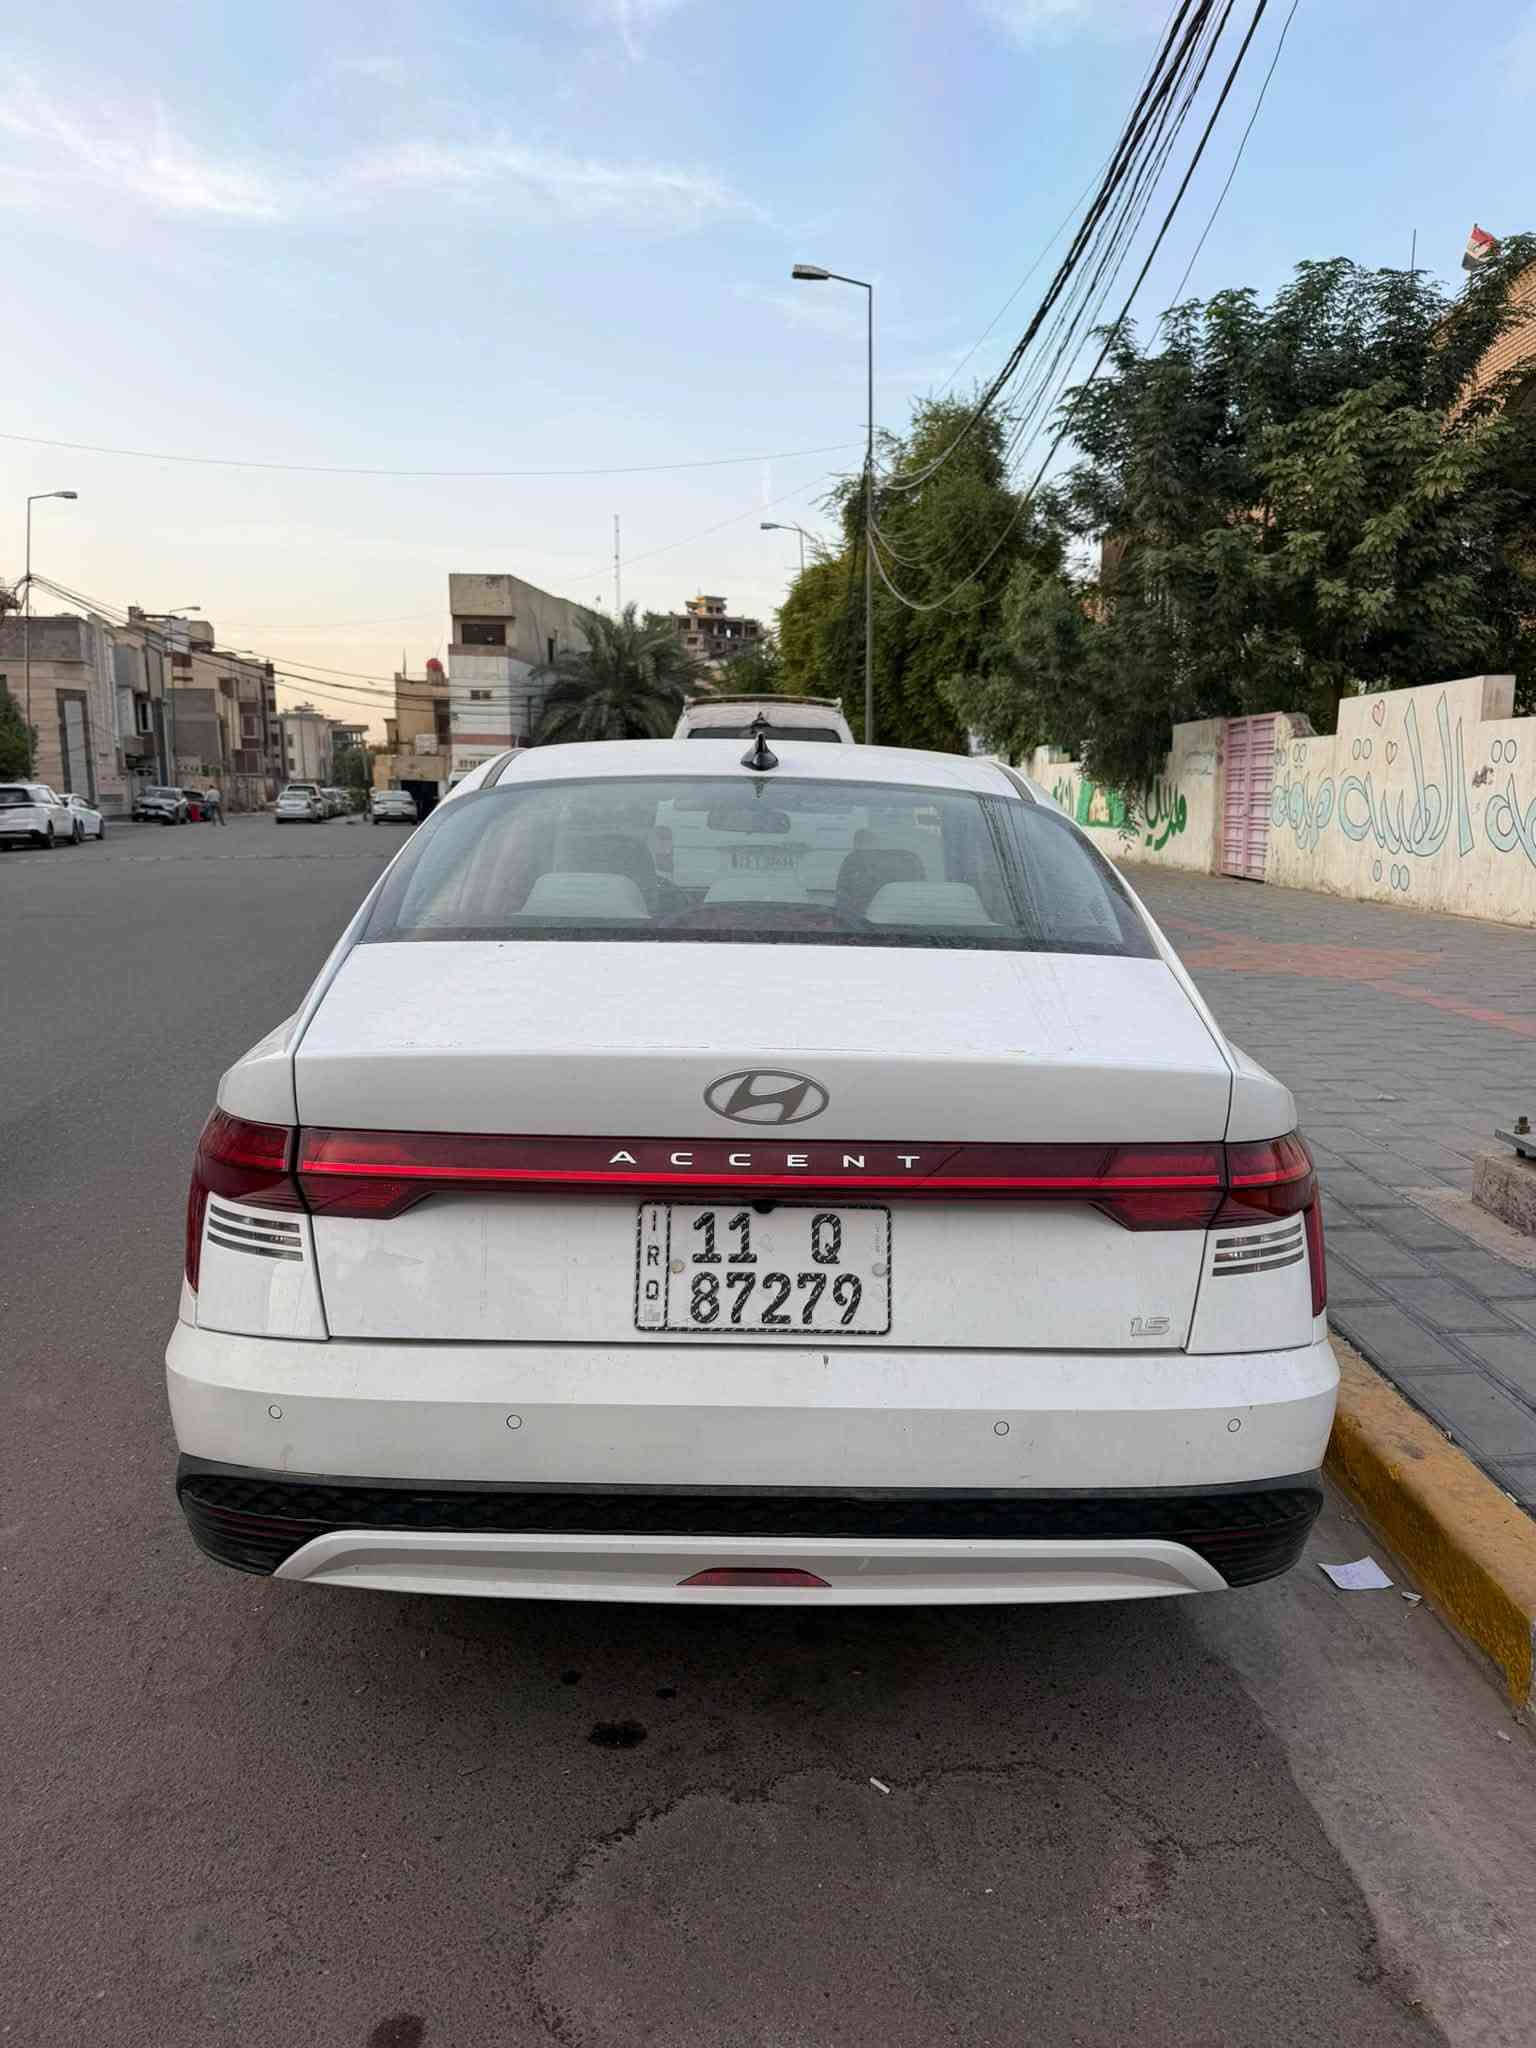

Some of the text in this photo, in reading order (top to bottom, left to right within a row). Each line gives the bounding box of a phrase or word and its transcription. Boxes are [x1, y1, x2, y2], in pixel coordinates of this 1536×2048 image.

[1339, 690, 1475, 891] الطيبة
[609, 1150, 921, 1169] ACCENT
[646, 1209, 660, 1301] IRQ
[692, 1211, 758, 1264] 11
[811, 1213, 842, 1265] Q
[689, 1271, 863, 1326] 87279
